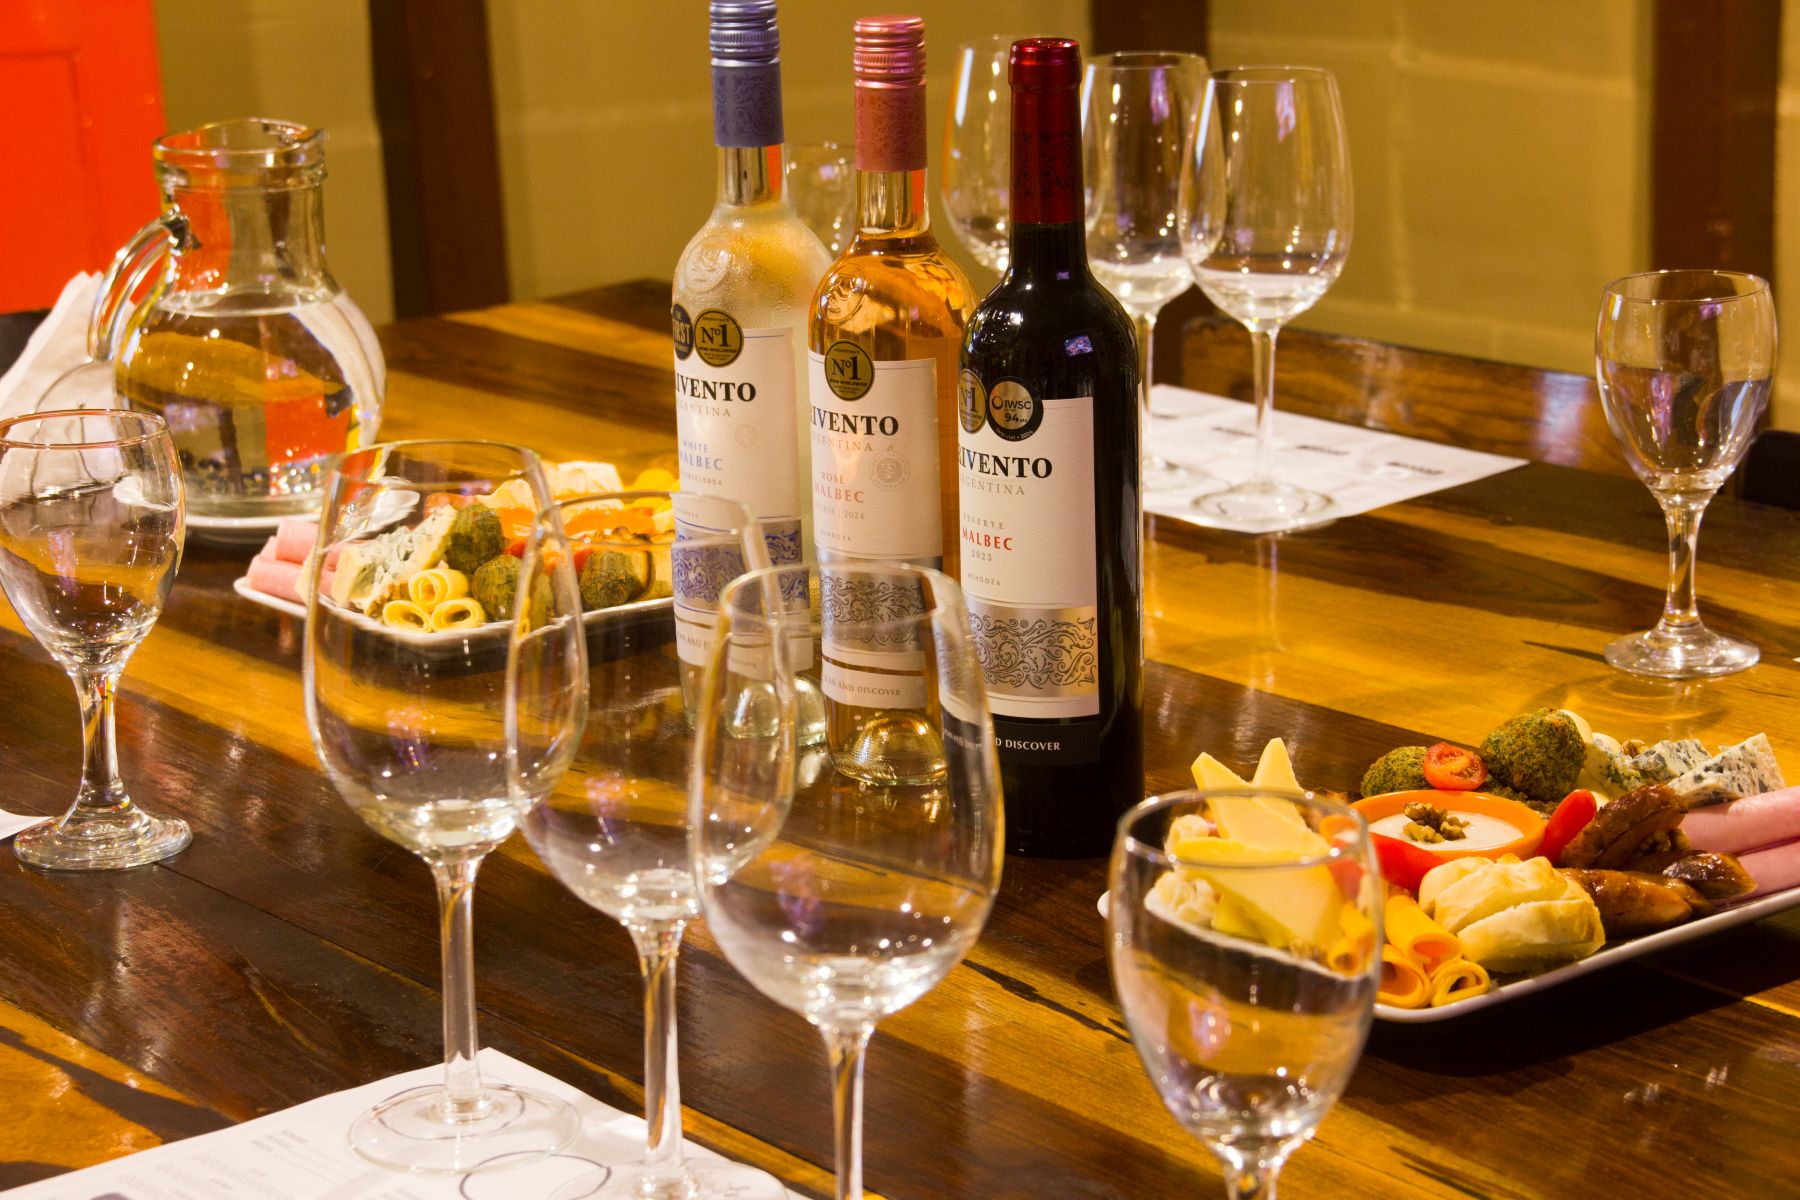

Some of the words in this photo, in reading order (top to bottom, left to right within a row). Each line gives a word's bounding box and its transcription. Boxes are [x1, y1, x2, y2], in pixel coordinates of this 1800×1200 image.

[677, 373, 756, 402] IVENTO
[1004, 399, 1032, 410] IWSC
[812, 405, 899, 436] IVENTO
[815, 481, 864, 504] MALBEC
[844, 510, 865, 520] 2024
[963, 527, 1013, 551] MALBEC
[971, 549, 992, 562] 2023
[858, 686, 901, 697] DISCOVER
[1005, 739, 1060, 751] DISCOVER
